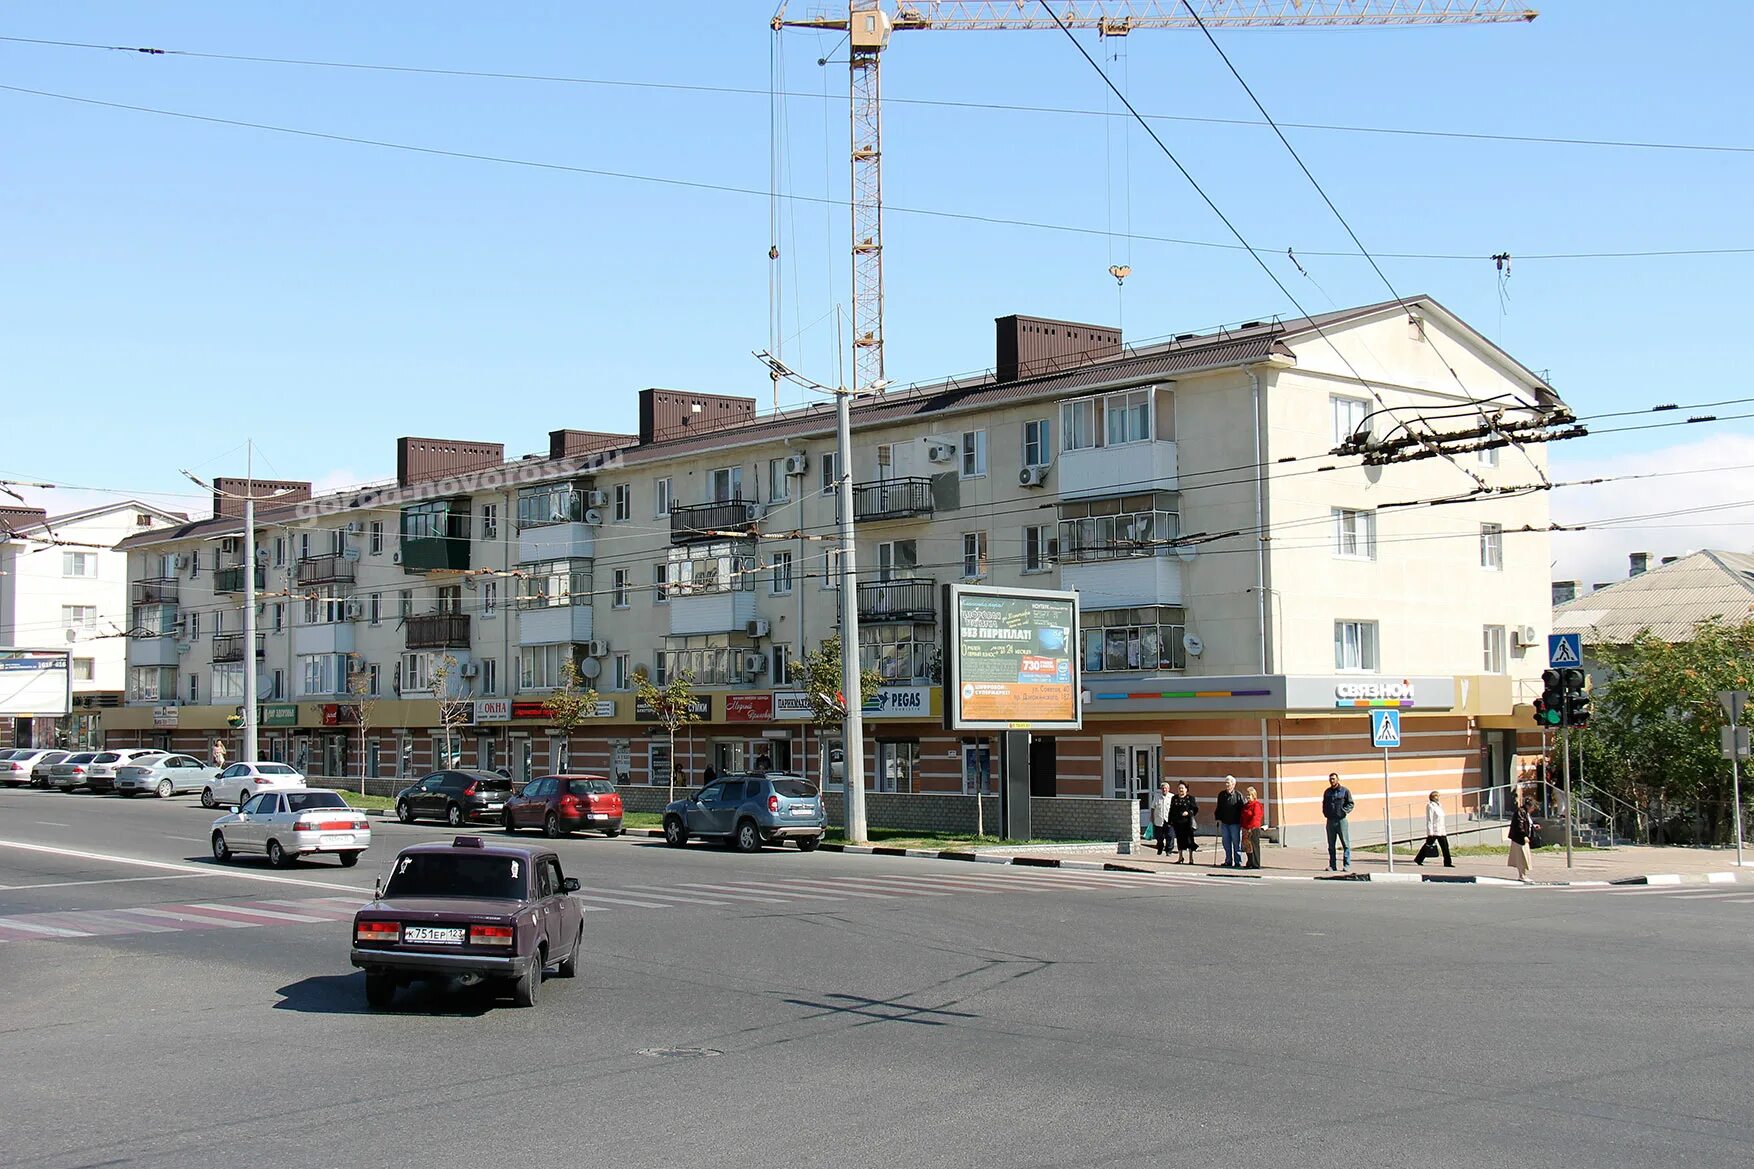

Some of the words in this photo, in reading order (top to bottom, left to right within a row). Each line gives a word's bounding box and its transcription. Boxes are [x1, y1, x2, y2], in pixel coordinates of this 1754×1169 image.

[1023, 661, 1040, 671] 730
[1335, 679, 1415, 699] СВЯЗНОЙ
[891, 692, 921, 708] PEGAS
[484, 702, 507, 713] ОКНА
